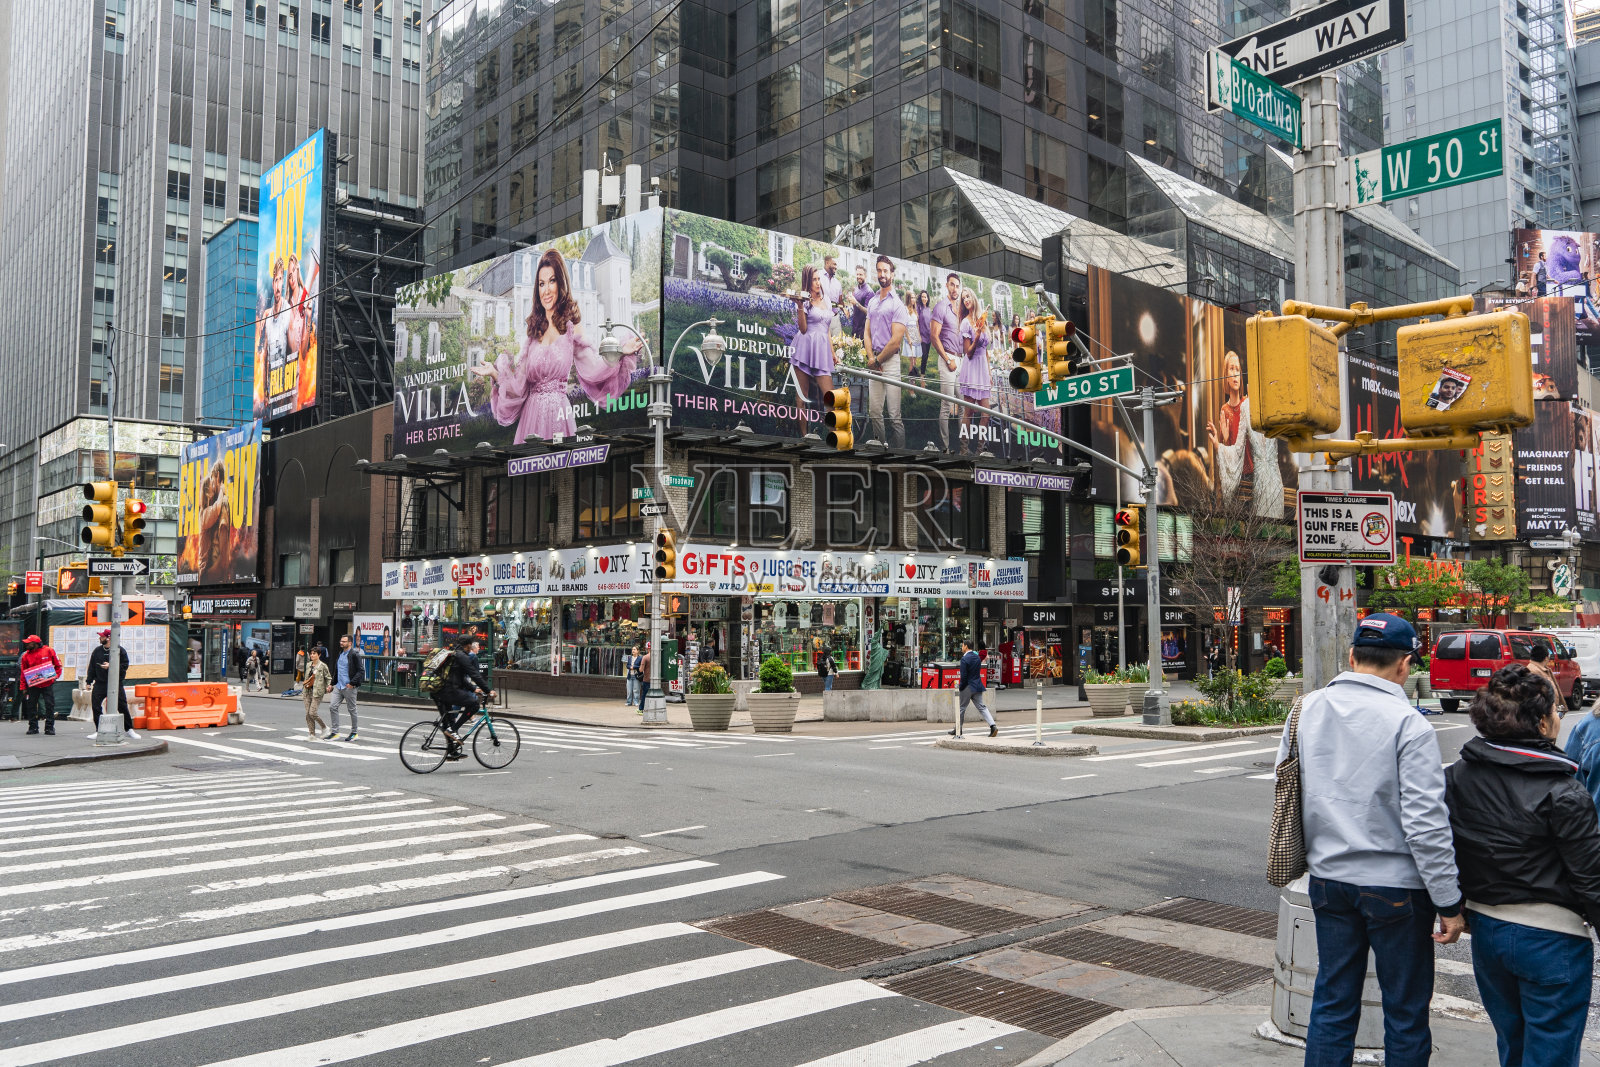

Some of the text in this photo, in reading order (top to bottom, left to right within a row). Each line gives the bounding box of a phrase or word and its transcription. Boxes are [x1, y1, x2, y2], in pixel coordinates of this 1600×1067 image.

[1315, 6, 1377, 52] WAY
[1318, 62, 1332, 71] DEPT
[1349, 38, 1398, 60] TRANSPORTATION
[1232, 66, 1299, 146] Broadway
[284, 137, 317, 191] PERCENT
[1386, 127, 1498, 192] W 50 St
[737, 320, 767, 336] hulu
[701, 333, 797, 359] NDERPUMP
[426, 350, 447, 365] hulu
[270, 366, 283, 397] FALL
[285, 360, 298, 391] GUY
[403, 363, 467, 388] VANDERPUMP
[687, 345, 813, 403] VILLA
[1046, 374, 1120, 402] W 50 ST
[1361, 377, 1400, 400] max ORIGINA
[396, 381, 478, 424] VILLA
[556, 388, 648, 421] APRIL 1 hulu
[675, 393, 823, 423] THEIR PLAYGROUND.
[406, 424, 464, 445] HER ESTATE.
[959, 423, 1001, 442] APRIL
[1003, 428, 1010, 443] 1
[1518, 450, 1569, 458] IMAGINARY
[510, 453, 566, 474] OUTFRONT
[1526, 464, 1563, 472] FRIENDS
[224, 442, 258, 529] GUY
[669, 477, 694, 487] Broadway
[977, 470, 1037, 487] OUTFRONT
[1472, 434, 1487, 523] NIORS
[1304, 508, 1353, 519] THIS IS A
[1304, 521, 1359, 532] GUN FREE
[1526, 520, 1552, 529] MAY
[1554, 520, 1567, 529] 17
[1305, 534, 1336, 544] ZONE
[97, 563, 141, 571] ONE WAY
[593, 555, 630, 574] I NY
[641, 552, 650, 567] I
[978, 562, 986, 570] WE
[763, 557, 817, 578] LUGGAGE
[899, 563, 938, 580] I NY
[941, 566, 962, 577] PREPAID
[978, 569, 991, 581] FIX
[996, 566, 1022, 577] CELLPHONE
[409, 571, 417, 583] FIX
[641, 569, 653, 584] N
[992, 575, 1024, 587] ACCESSORIES
[475, 587, 487, 595] FDNY
[514, 584, 539, 593] LUGGAGE
[561, 583, 588, 592] BRANDS
[682, 581, 699, 589] 1628
[718, 583, 741, 591] NYPD
[787, 584, 806, 592] FDNY
[852, 584, 887, 593] LUGGAGE
[897, 586, 941, 595] ALL BRANDS
[192, 600, 214, 614] MAJESTIC
[214, 599, 239, 607] DELICATESSEN
[240, 599, 251, 607] CAFE
[1033, 612, 1056, 621] SPIN
[1165, 612, 1183, 620] SPIN
[361, 622, 385, 631] INJURED?
